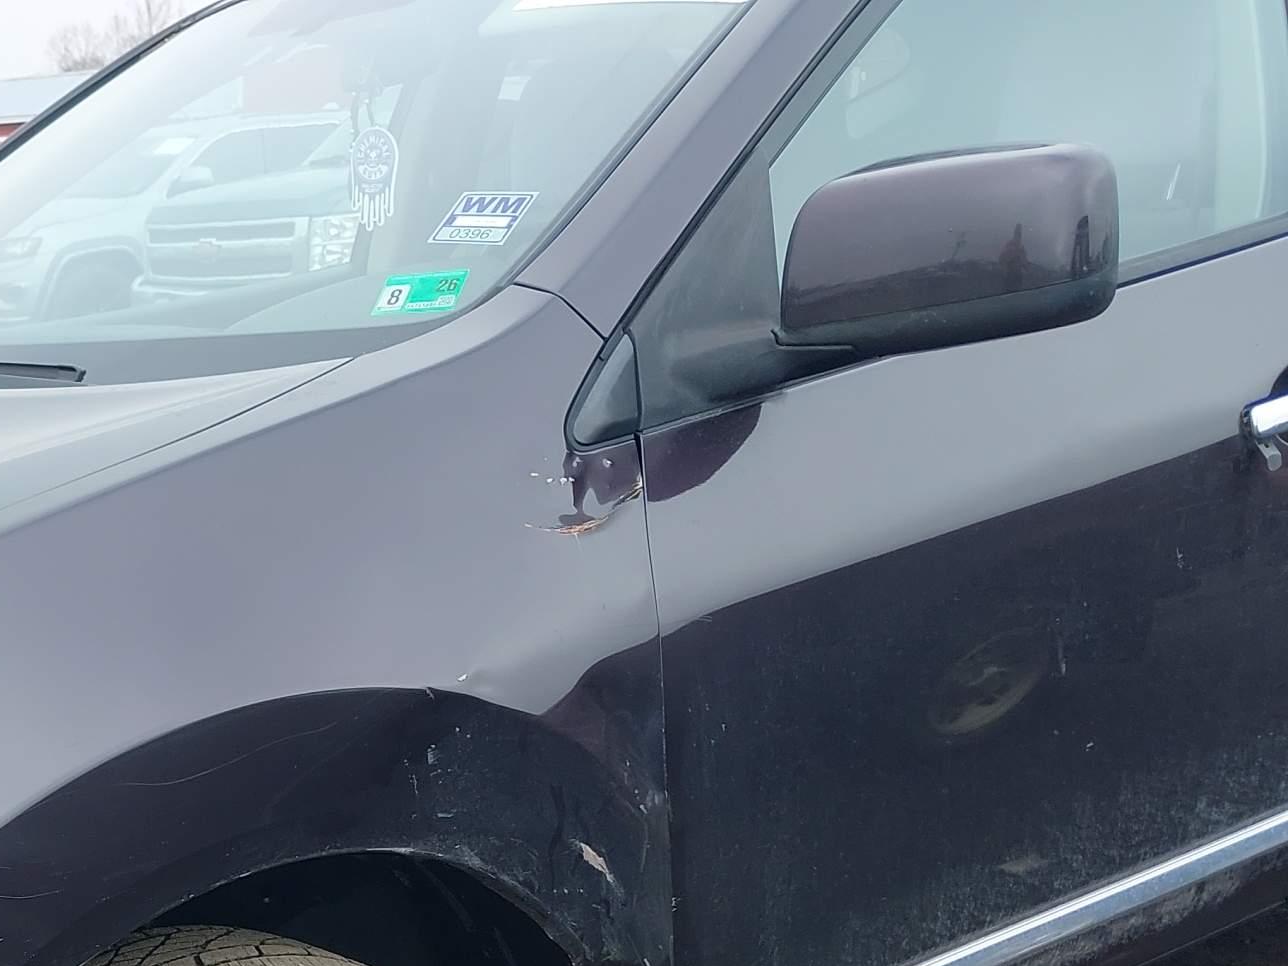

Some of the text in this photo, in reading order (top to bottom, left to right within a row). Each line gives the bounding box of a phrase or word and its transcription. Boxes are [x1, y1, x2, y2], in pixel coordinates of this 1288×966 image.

[461, 196, 528, 214] WM
[448, 227, 493, 240] 0396
[436, 278, 460, 292] 26
[386, 288, 404, 306] 8
